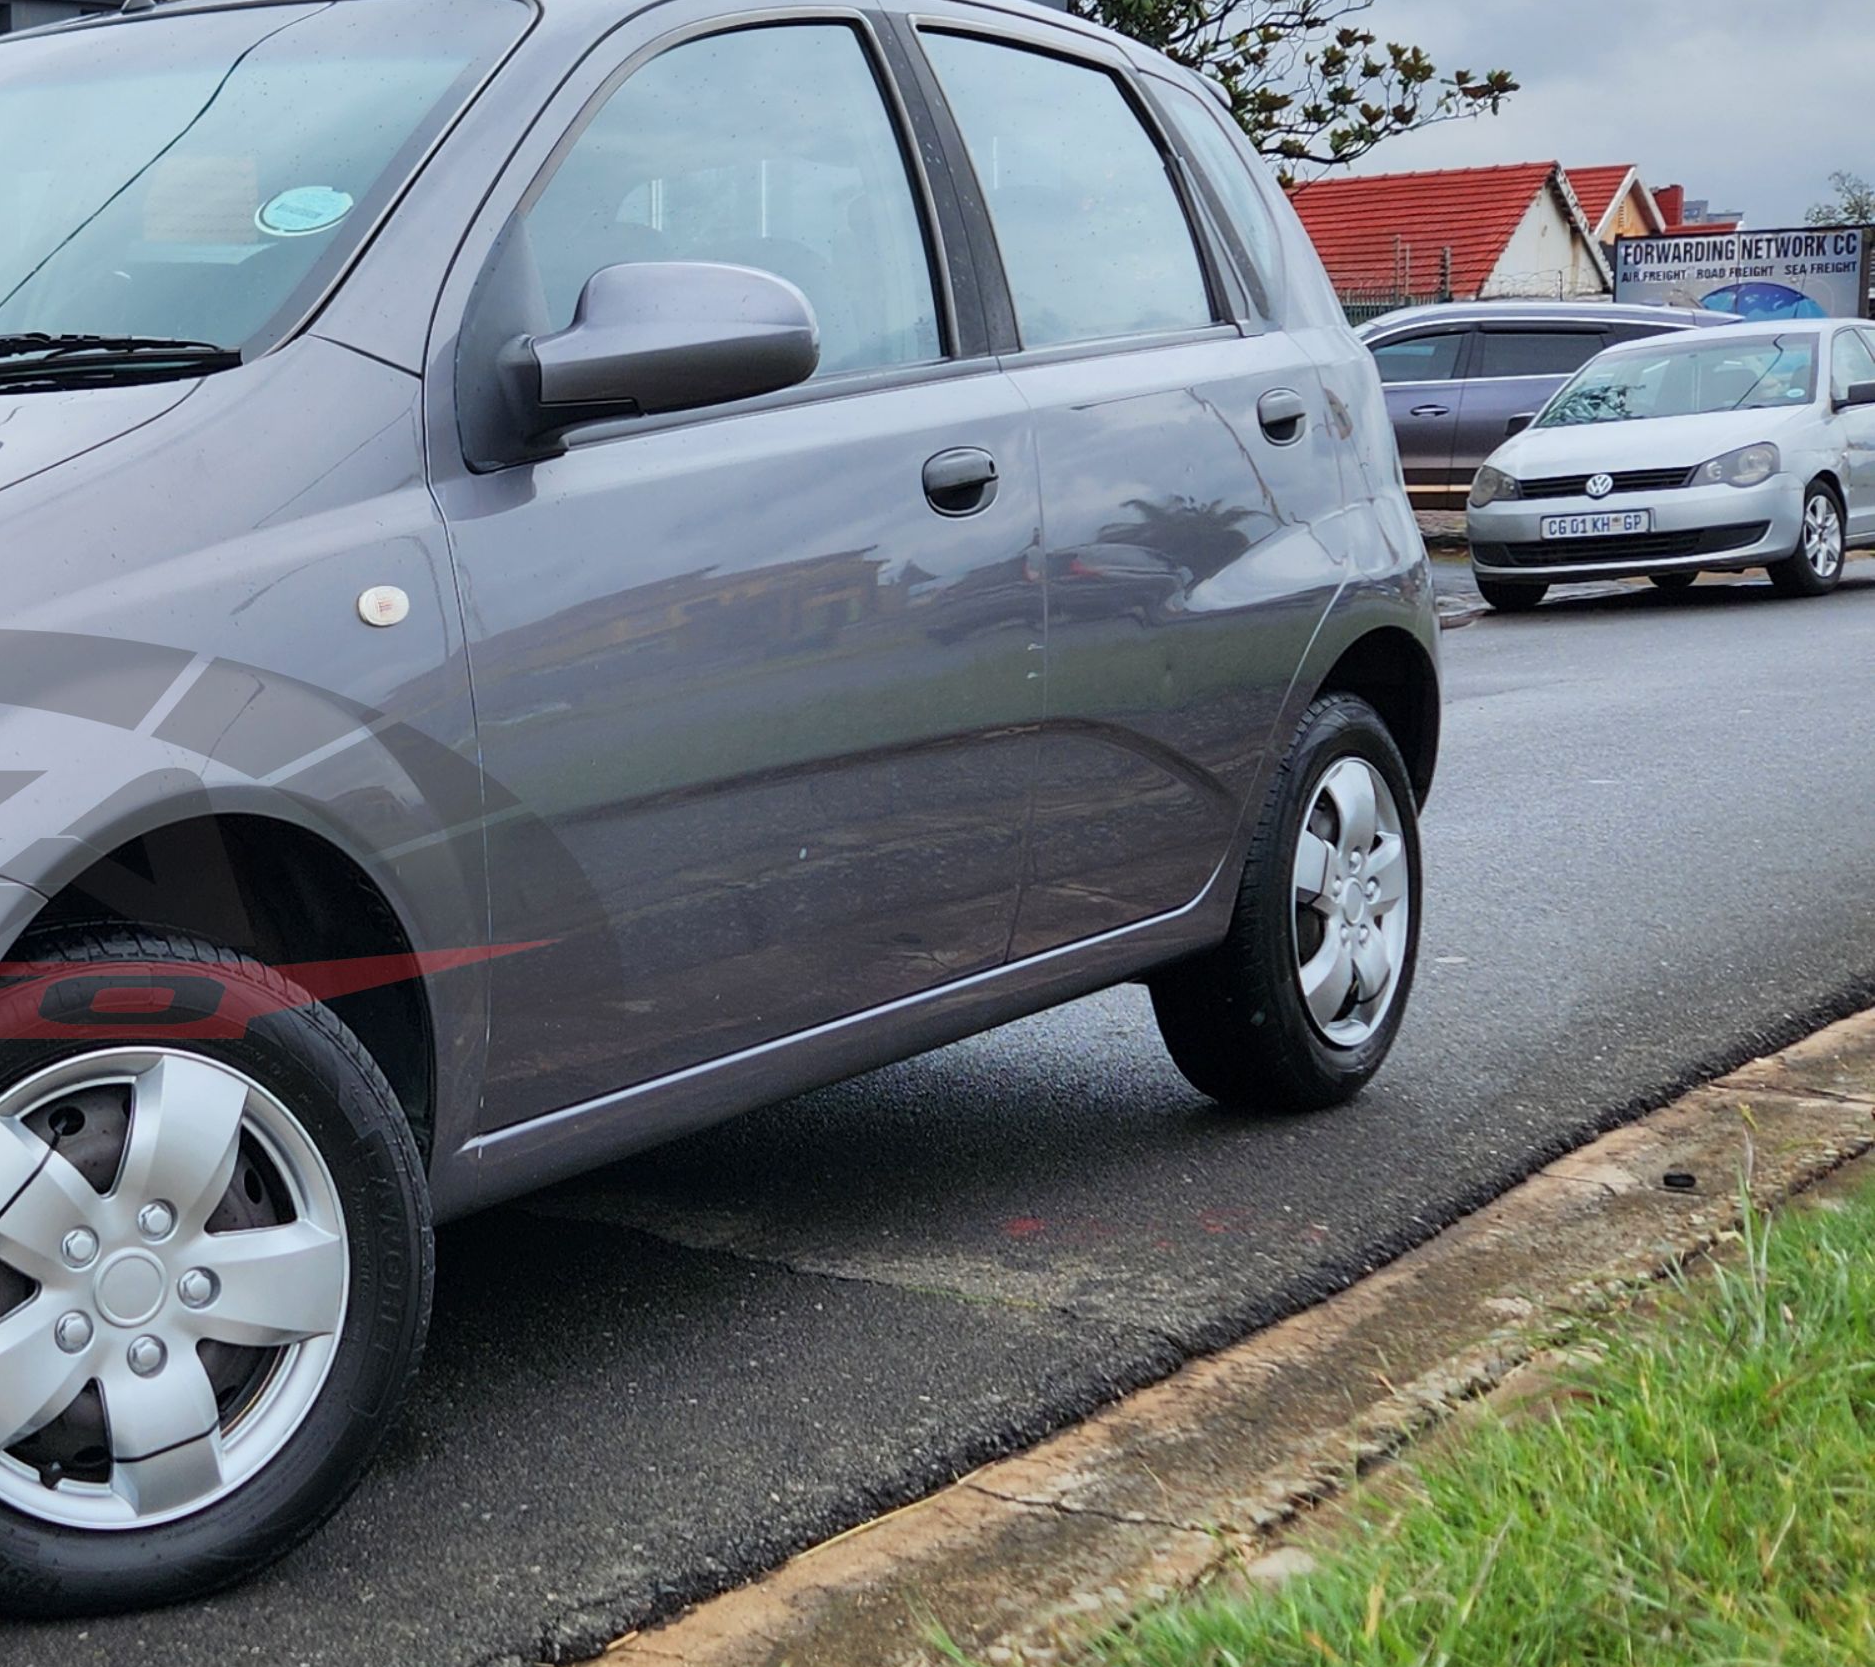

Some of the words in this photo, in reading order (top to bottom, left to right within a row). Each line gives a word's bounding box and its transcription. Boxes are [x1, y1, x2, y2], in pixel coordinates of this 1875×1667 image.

[1623, 239, 1734, 265] FORWARDING
[1741, 235, 1826, 260] NETWORK
[1833, 233, 1857, 255] CC
[1696, 267, 1726, 279] ROAD
[1729, 265, 1774, 278] FREIGHT
[1784, 264, 1807, 276] SEA
[1810, 261, 1857, 274] FREIGHT
[1592, 517, 1610, 533] KH
[1624, 514, 1641, 531] GP
